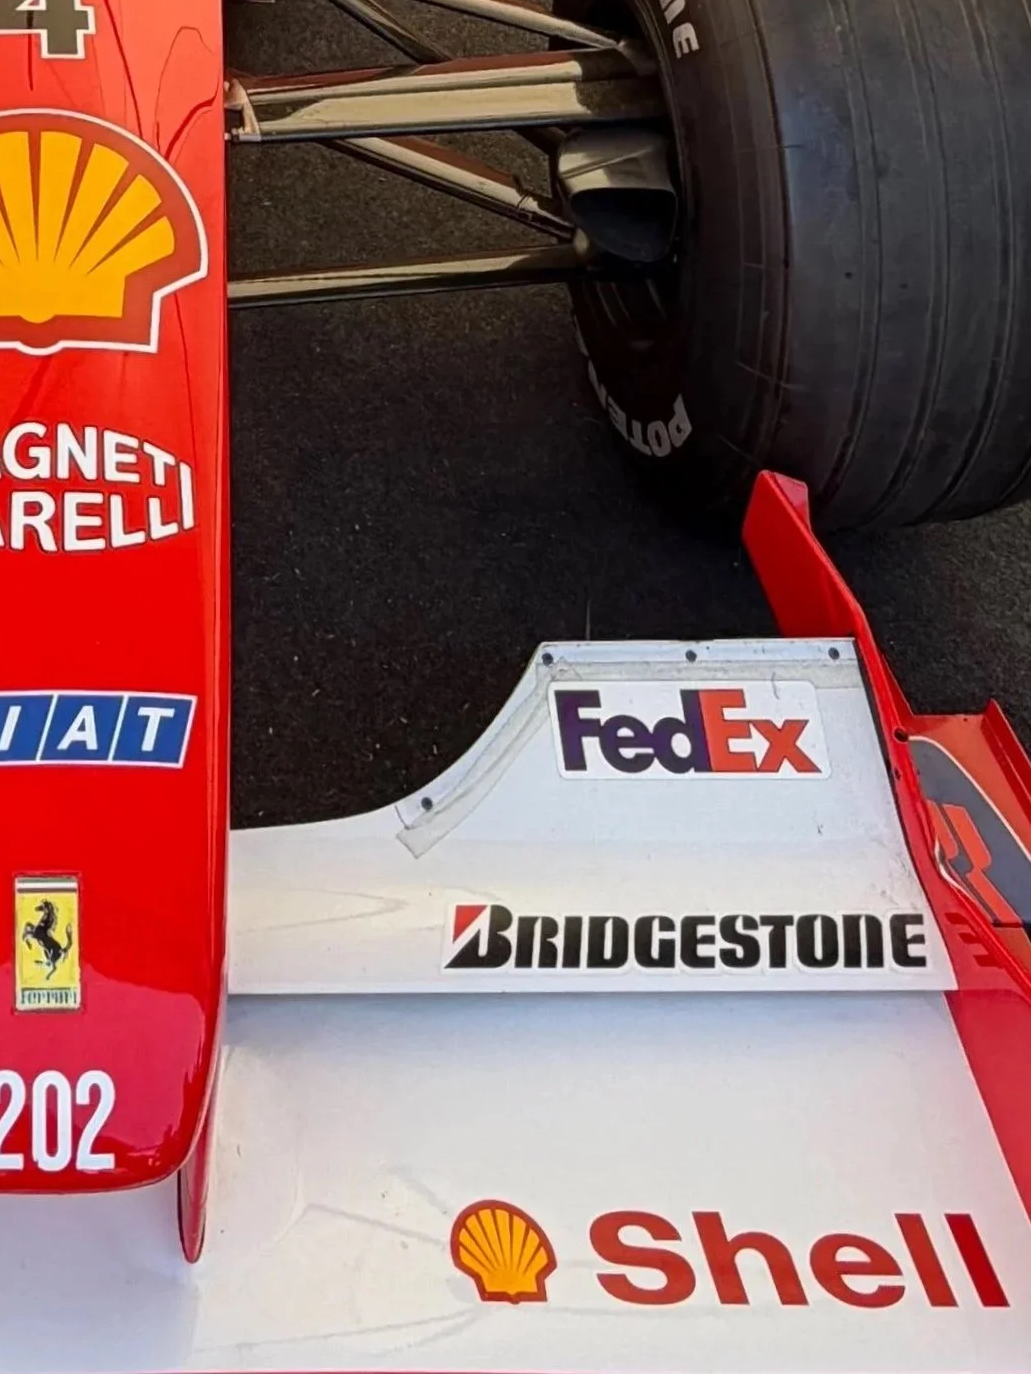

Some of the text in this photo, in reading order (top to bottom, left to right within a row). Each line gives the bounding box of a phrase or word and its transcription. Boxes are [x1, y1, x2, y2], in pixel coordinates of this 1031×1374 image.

[554, 689, 822, 774] FedEx
[444, 905, 928, 970] BRIDGESTONE
[589, 1211, 1011, 1309] Shell
